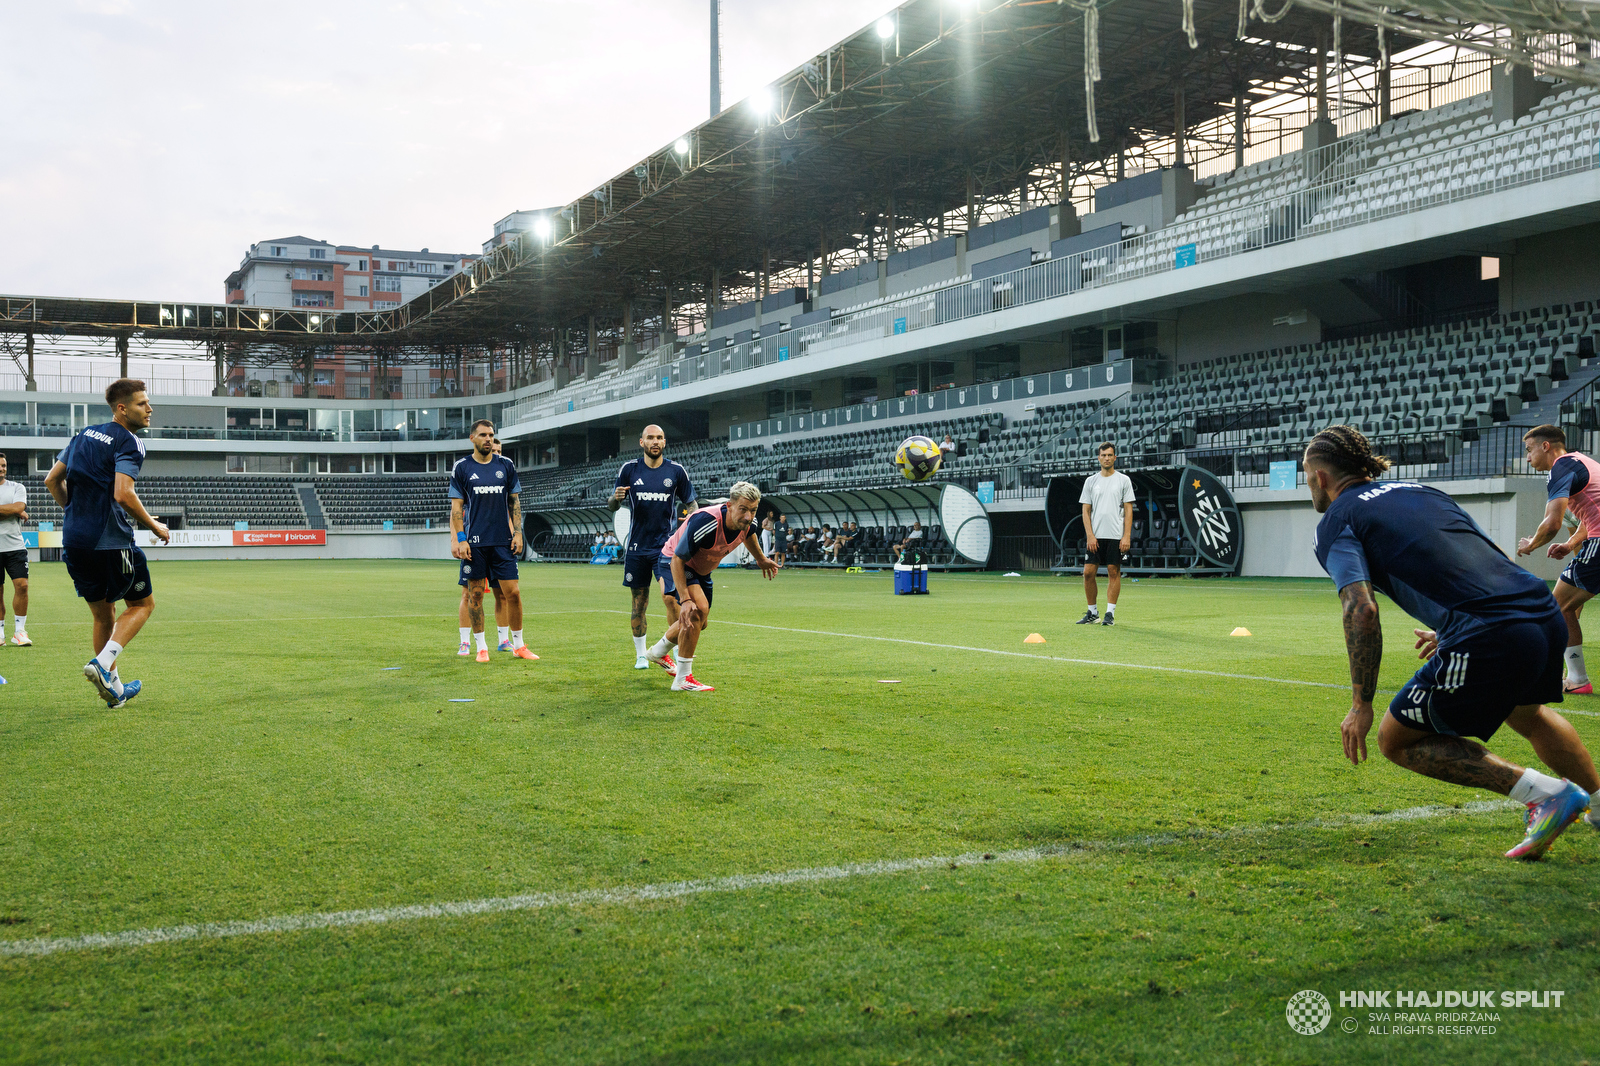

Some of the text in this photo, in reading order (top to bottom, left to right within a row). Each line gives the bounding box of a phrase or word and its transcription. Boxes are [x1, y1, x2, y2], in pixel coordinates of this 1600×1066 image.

[83, 428, 114, 445] HAJDUK
[473, 485, 505, 494] TOMMY
[636, 492, 671, 502] TOMMY
[193, 533, 221, 542] OLIVES
[472, 535, 480, 543] 31
[1216, 545, 1232, 559] 1937
[1407, 684, 1426, 704] 10
